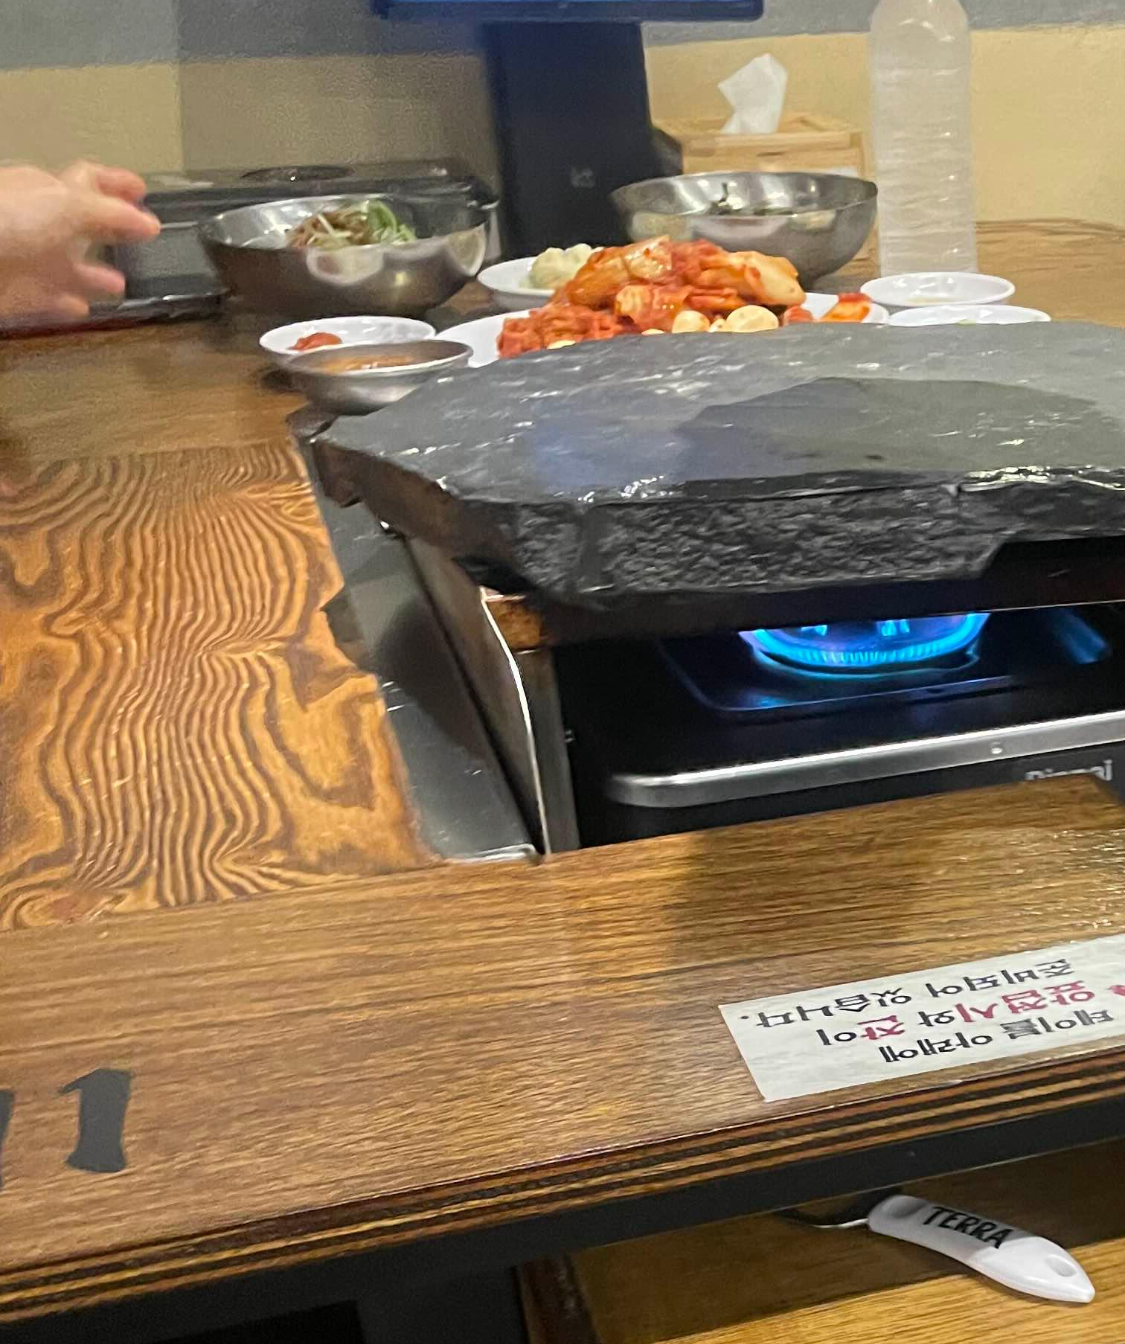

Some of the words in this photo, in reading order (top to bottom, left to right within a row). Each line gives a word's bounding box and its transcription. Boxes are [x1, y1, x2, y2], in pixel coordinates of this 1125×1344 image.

[925, 958, 1074, 998] 준비되어
[740, 987, 912, 1028] 있습니다.
[918, 980, 1095, 1028] 앞접시와
[816, 1014, 905, 1046] 잔이
[1000, 1009, 1114, 1040] 테이블
[878, 1032, 993, 1063] 아래에
[923, 1206, 1015, 1250] TERRA
